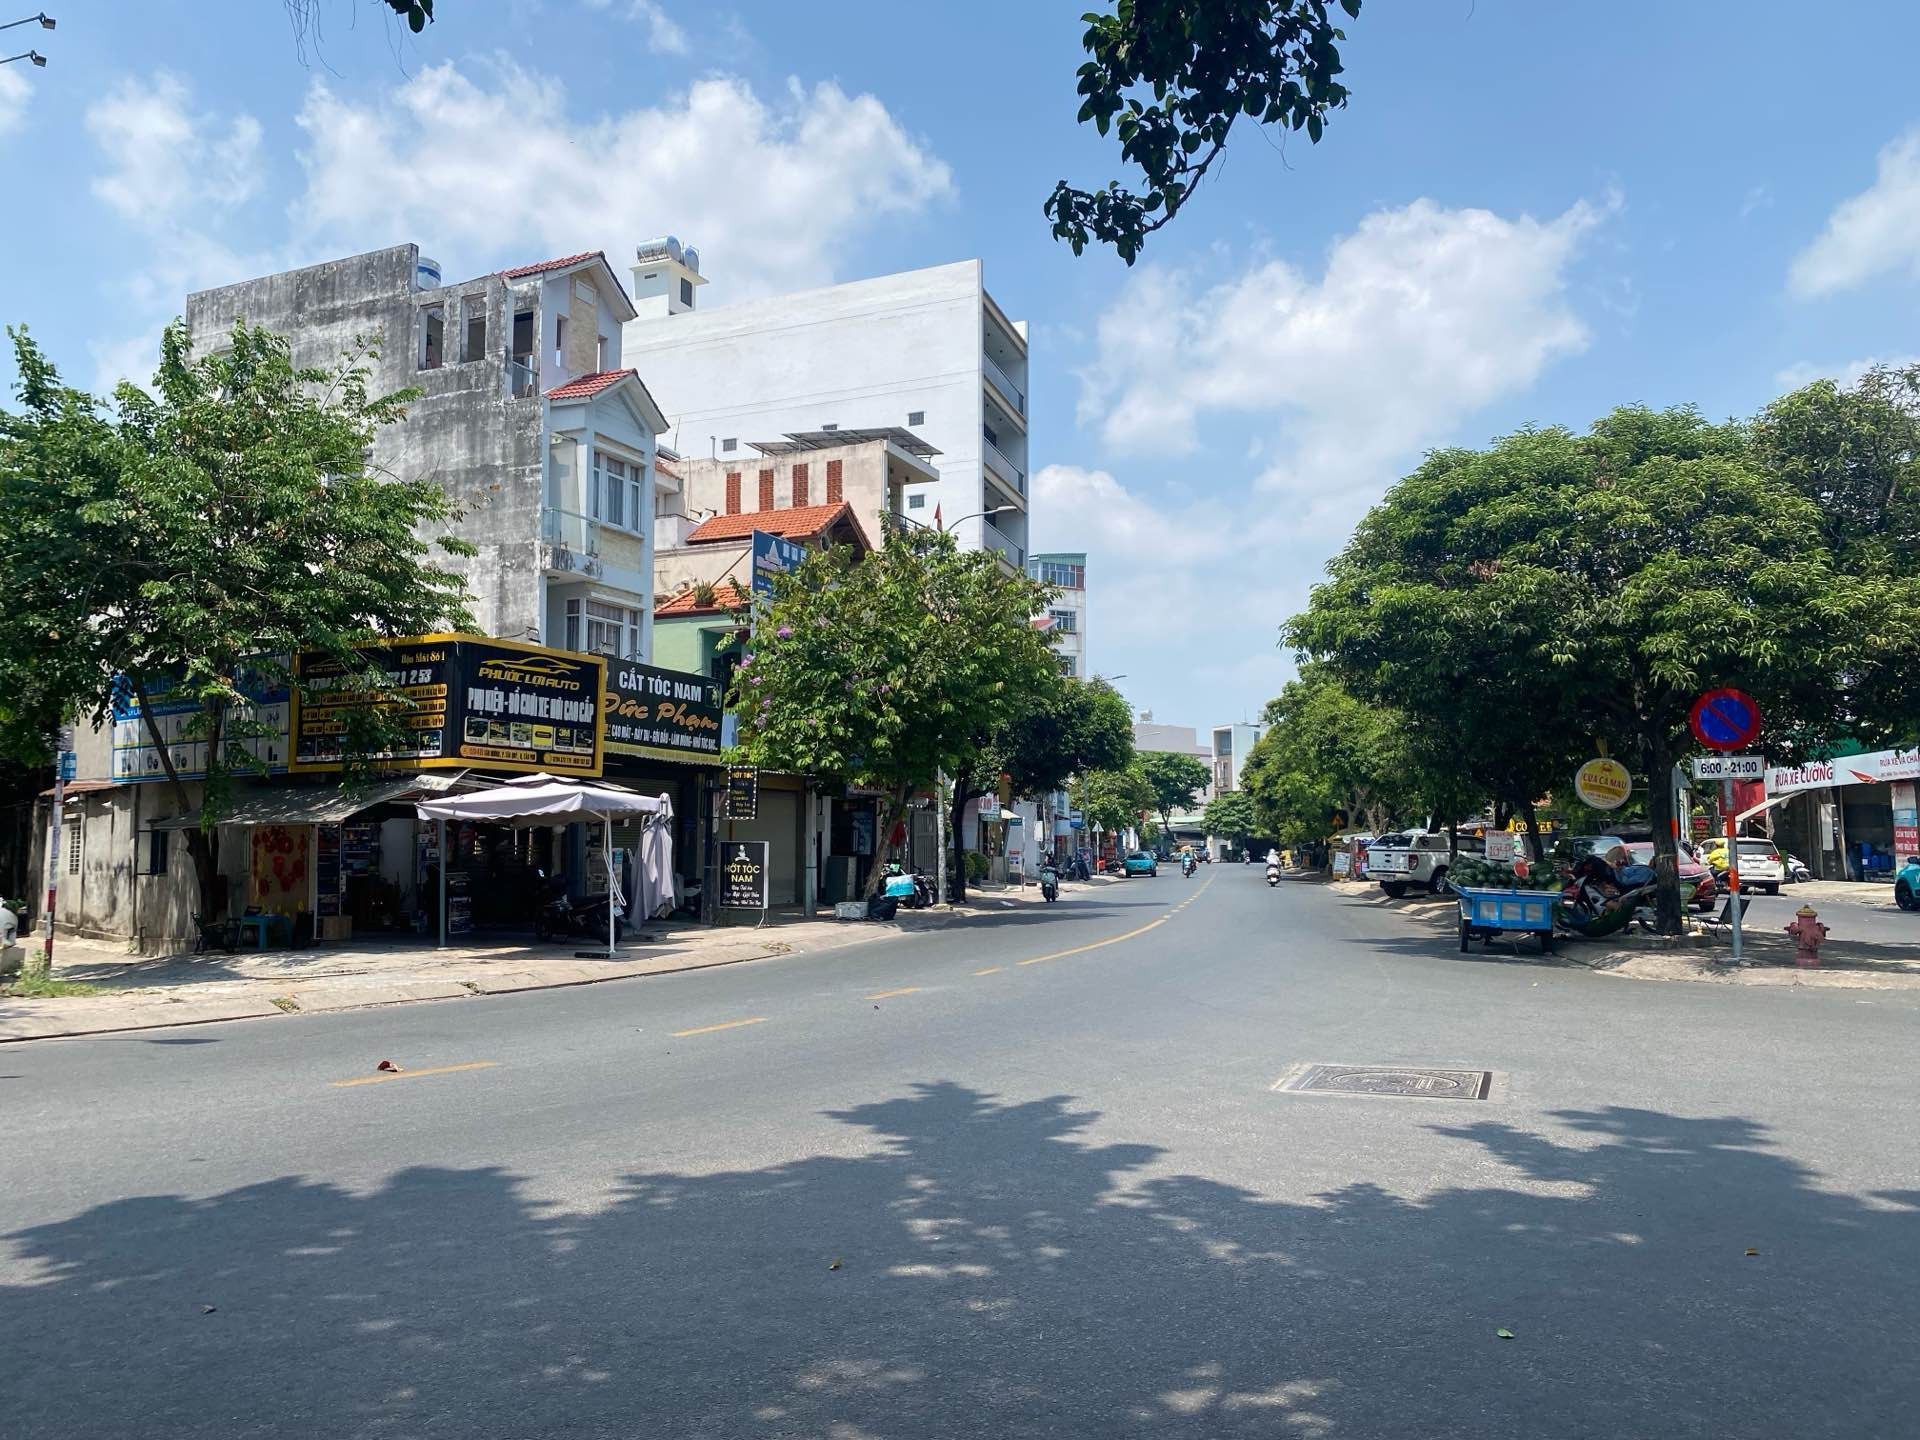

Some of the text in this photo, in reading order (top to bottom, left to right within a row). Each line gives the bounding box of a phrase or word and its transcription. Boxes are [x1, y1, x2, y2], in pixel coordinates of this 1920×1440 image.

[545, 679, 580, 691] AUTO
[619, 667, 702, 703] CẮT TÓC NAM
[538, 696, 550, 719] XE
[563, 700, 579, 722] CAO
[1700, 763, 1721, 774] 6:00
[1730, 762, 1757, 773] 21:00
[1775, 766, 1834, 787] RỬA XE CƯỜNG
[724, 863, 760, 874] HỚT TÓC
[731, 874, 753, 883] NAM
